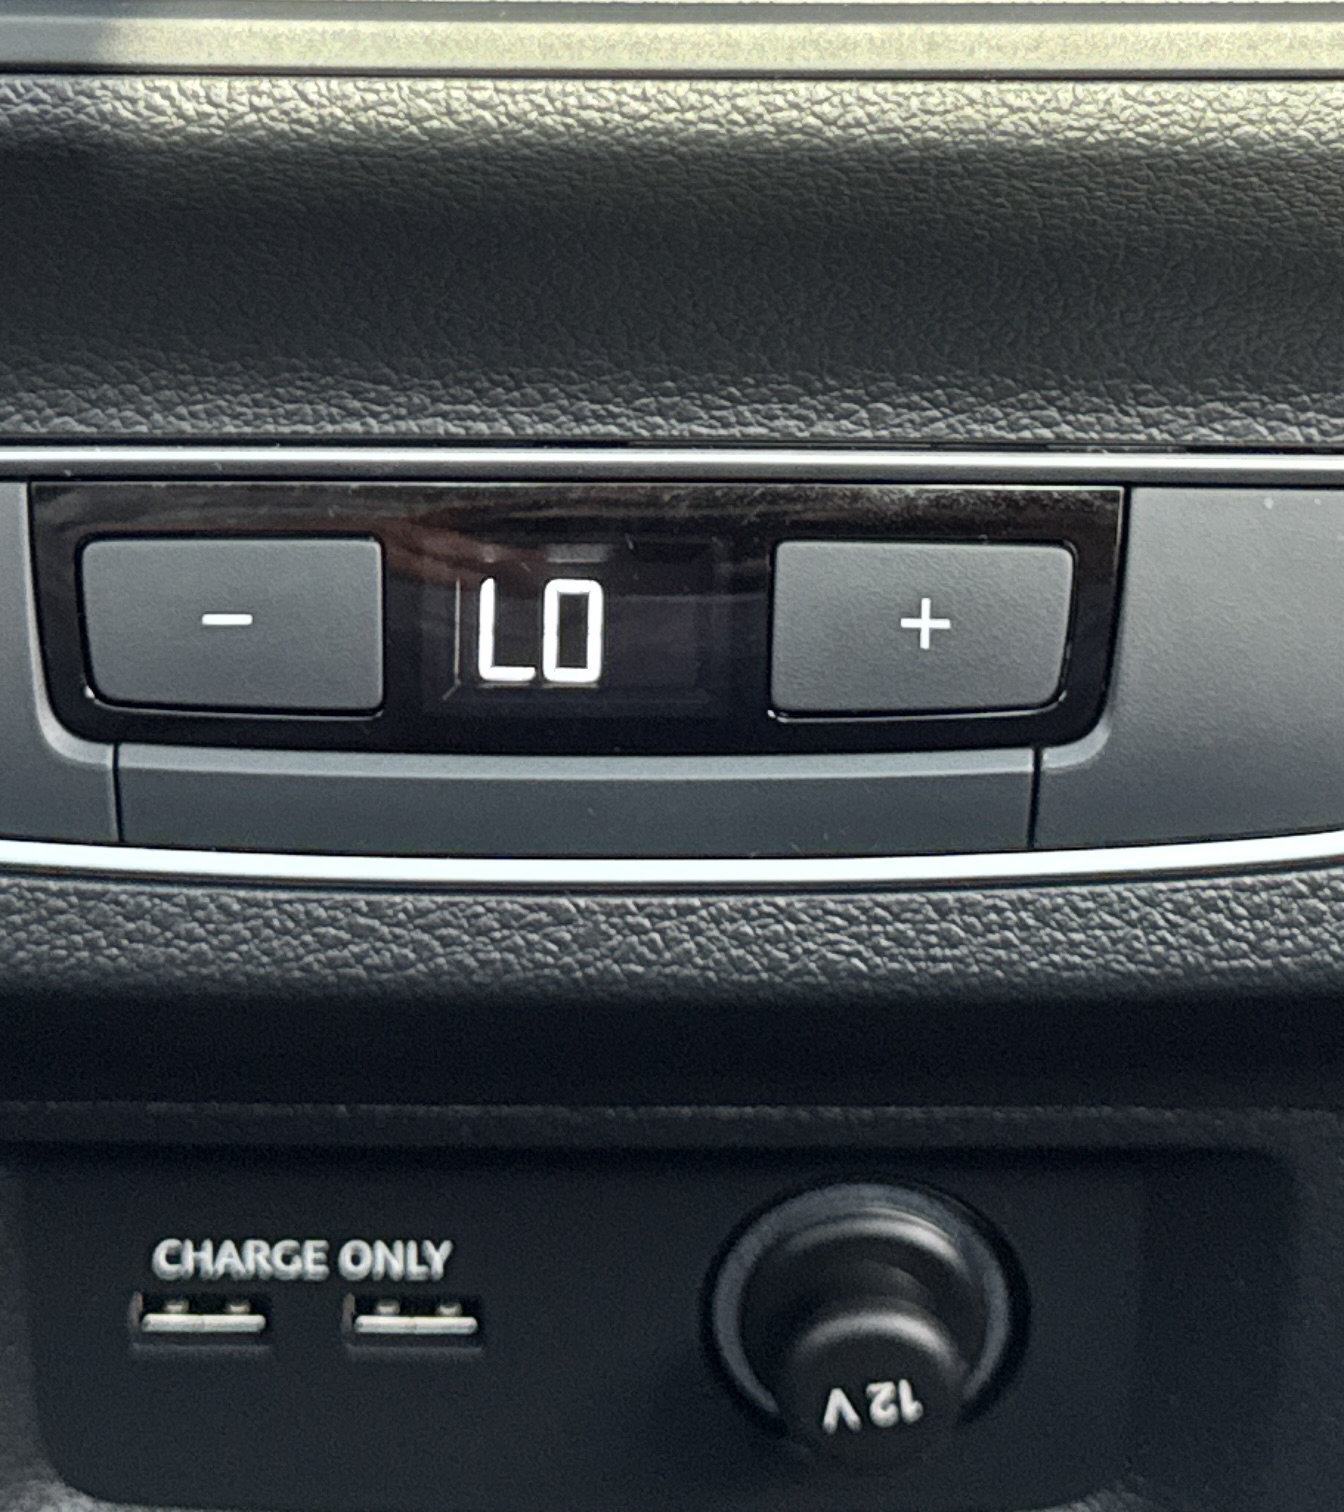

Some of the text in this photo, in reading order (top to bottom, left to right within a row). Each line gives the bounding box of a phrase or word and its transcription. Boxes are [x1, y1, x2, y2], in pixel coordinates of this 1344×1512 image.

[477, 577, 604, 683] LO
[152, 1238, 454, 1282] CHARGE ONLY
